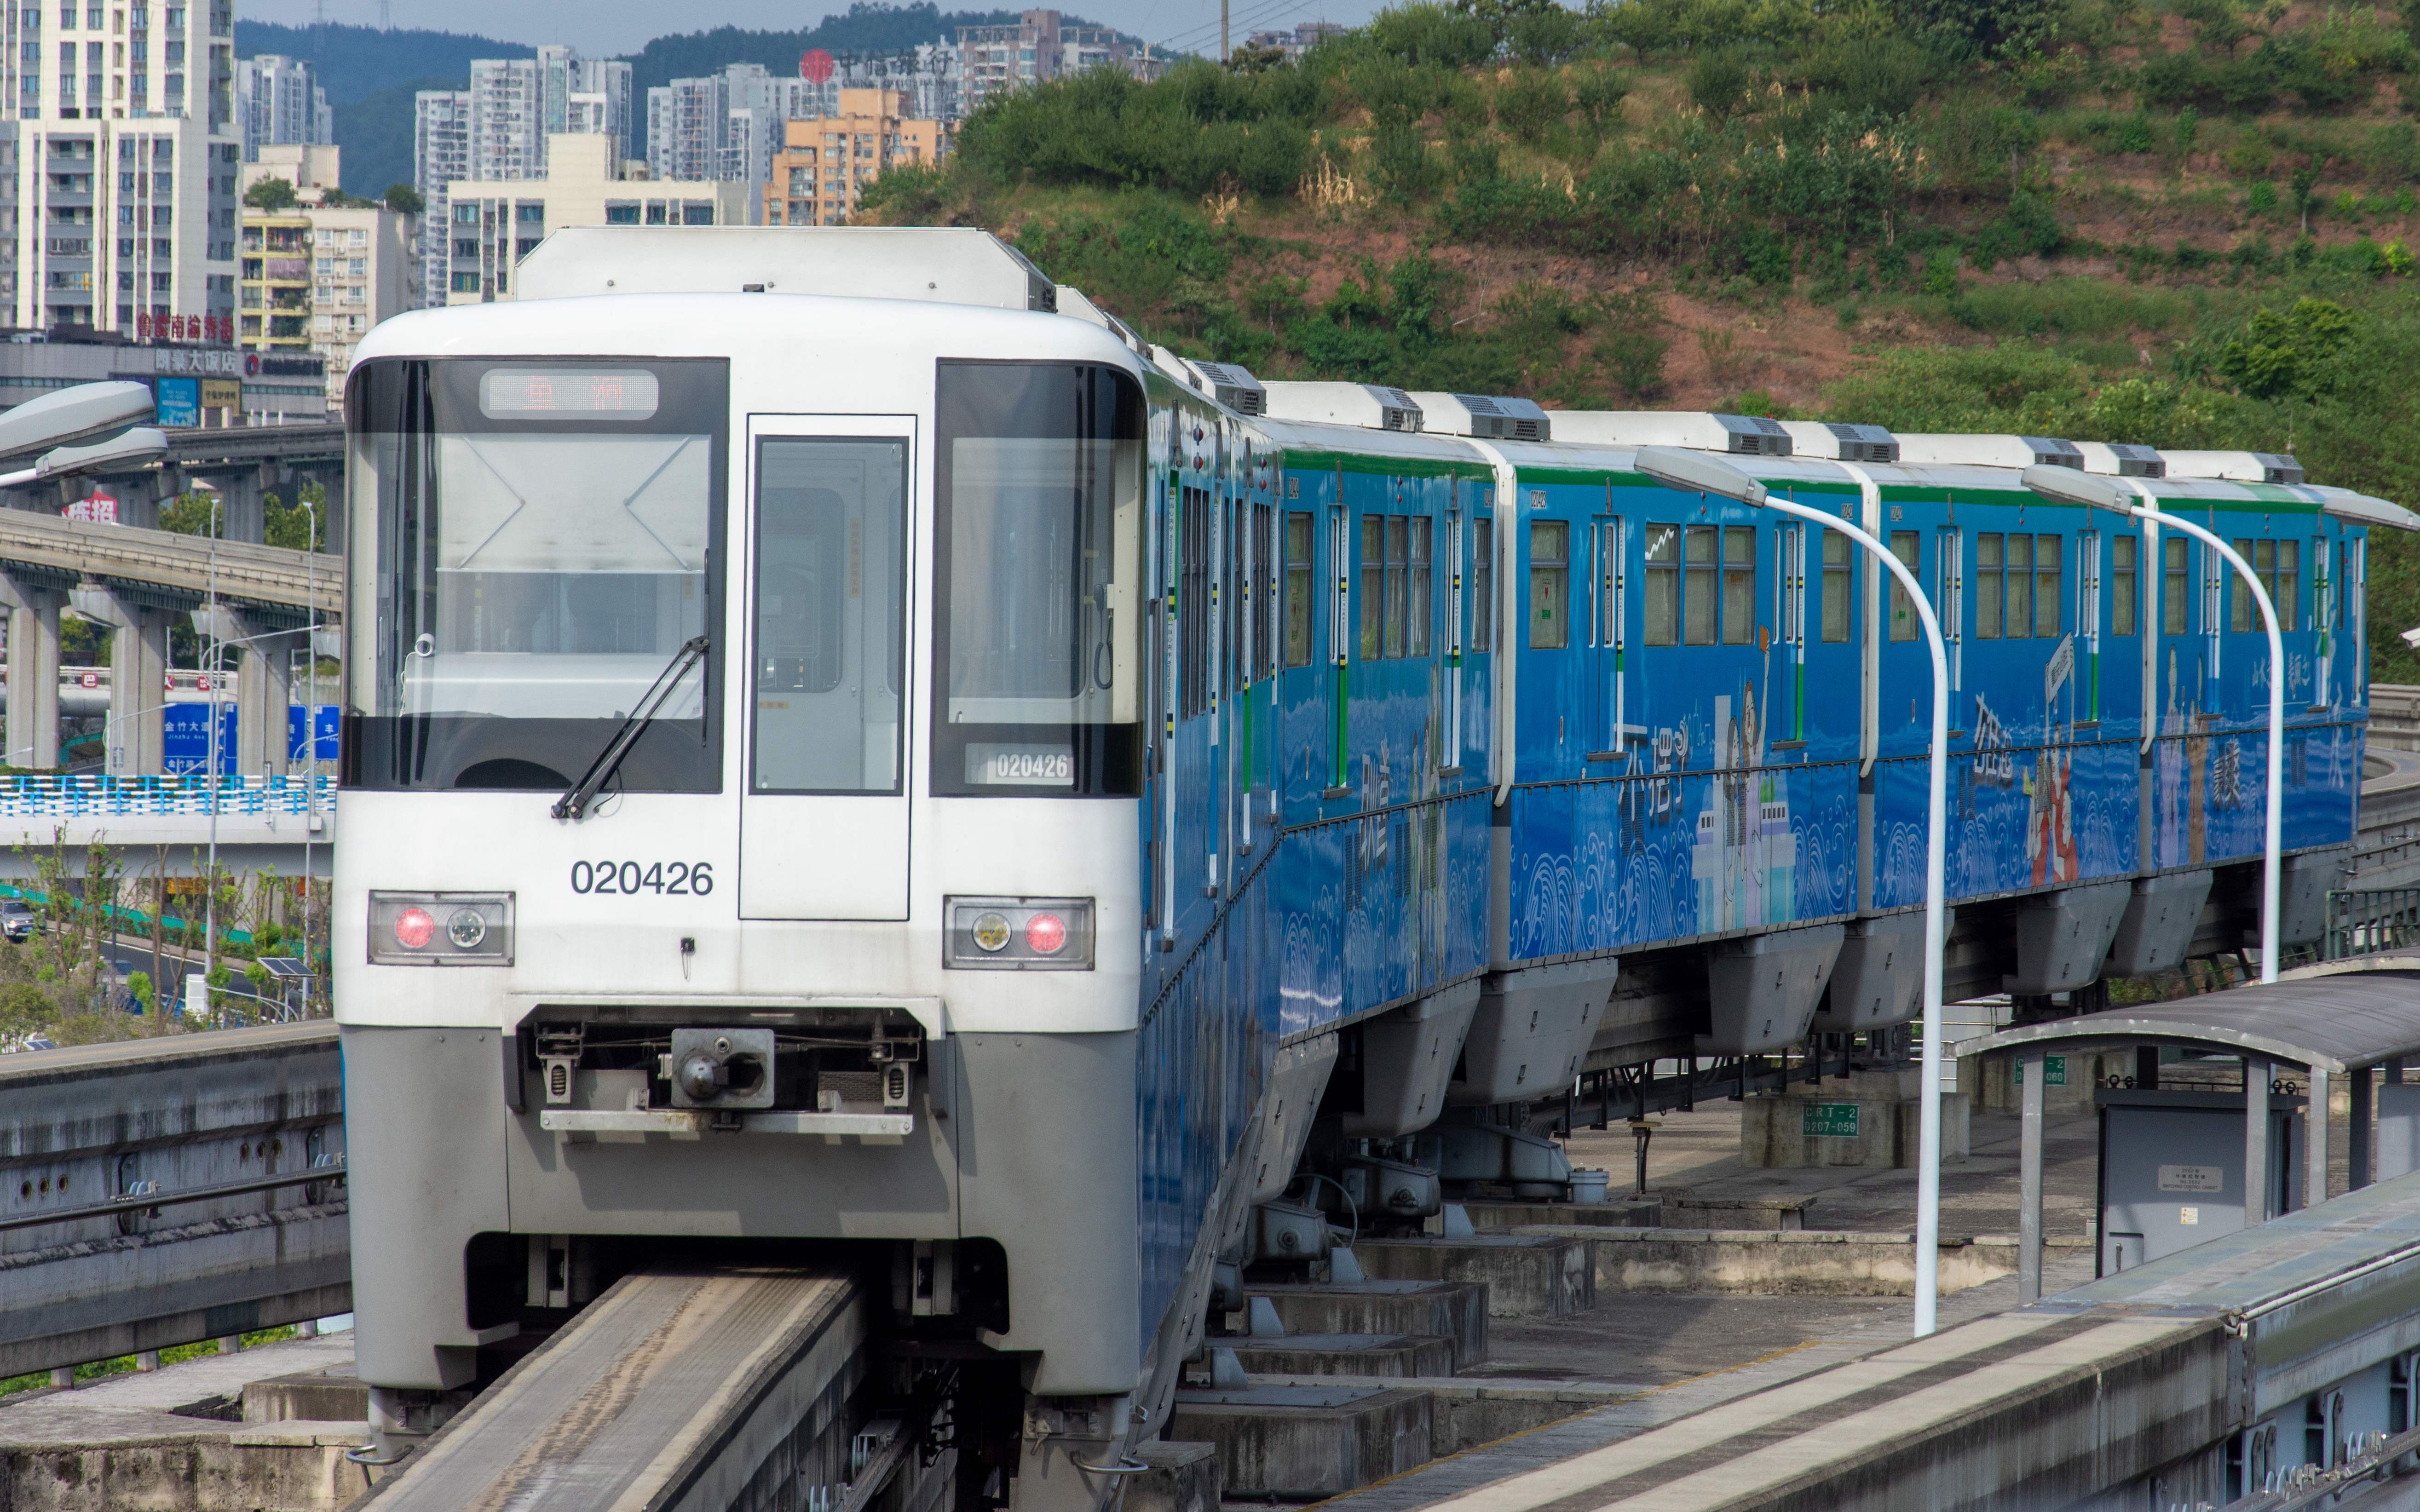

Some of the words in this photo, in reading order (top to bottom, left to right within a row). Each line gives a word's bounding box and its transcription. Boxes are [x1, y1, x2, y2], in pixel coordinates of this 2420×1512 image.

[840, 47, 953, 76] 中信银行
[1531, 491, 1546, 507] 020423
[165, 721, 209, 732] 金竹大道
[997, 754, 1067, 777] 020426
[571, 860, 713, 896] 020426
[1805, 1121, 1855, 1132] D207-059
